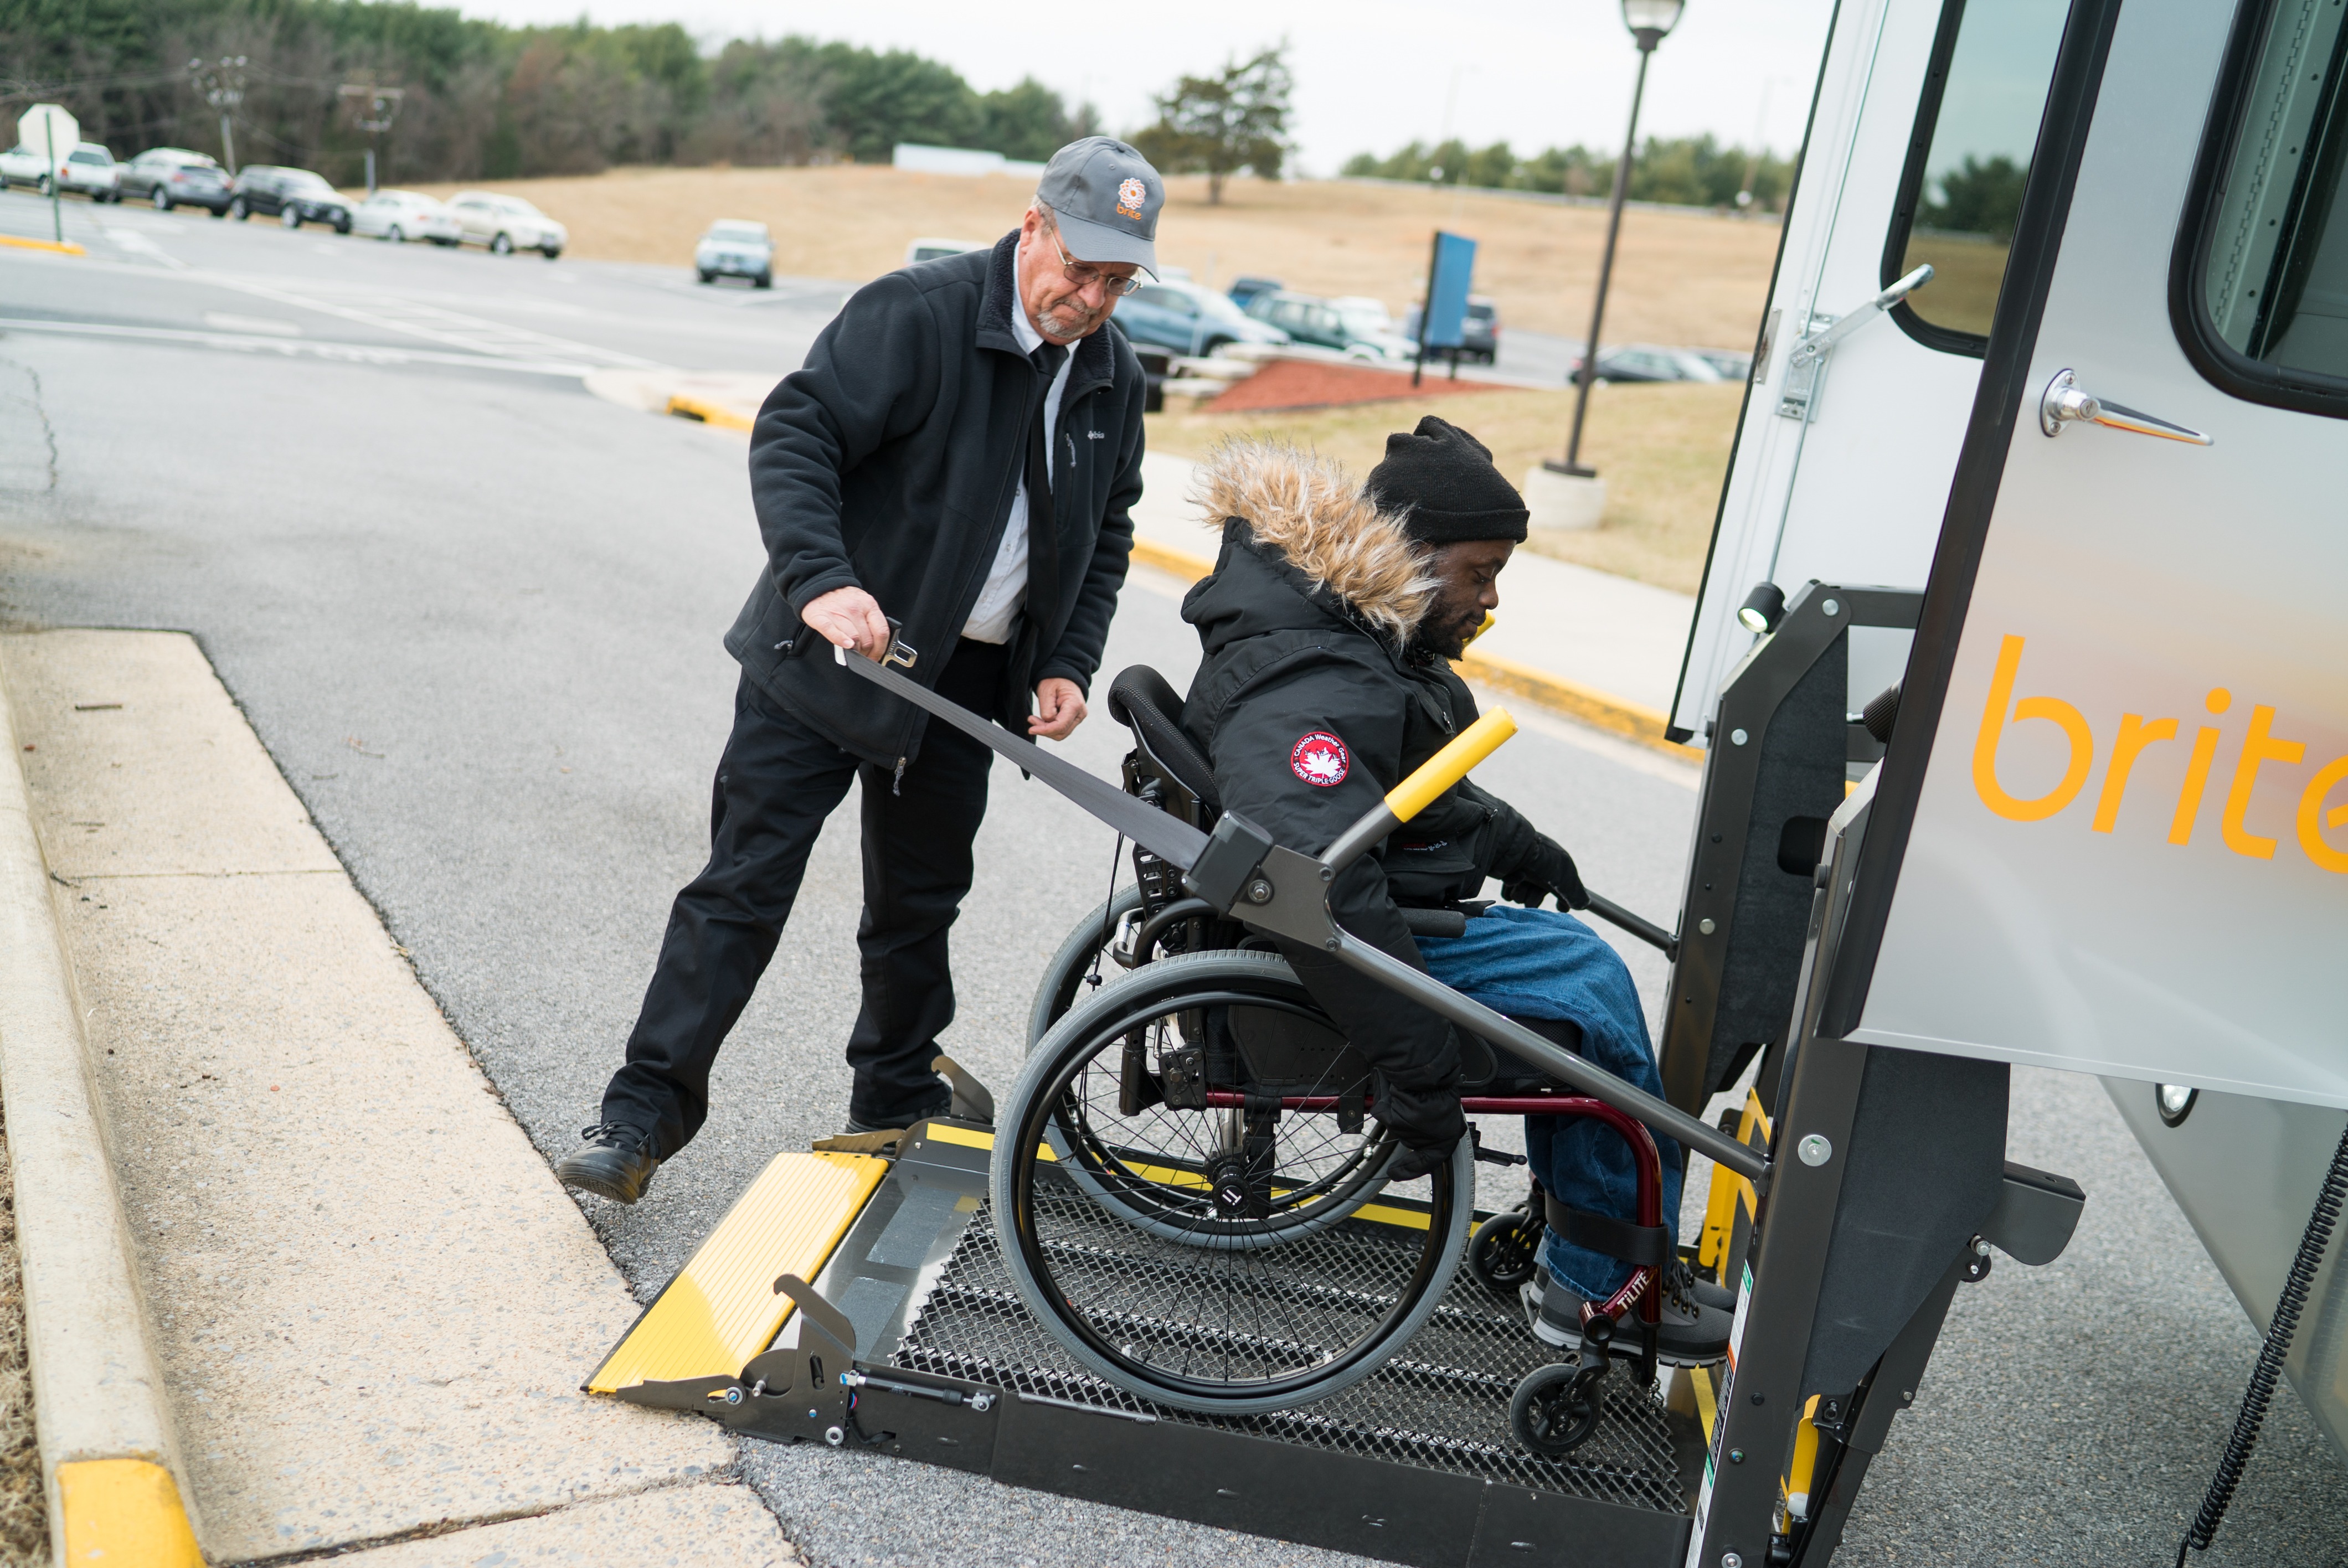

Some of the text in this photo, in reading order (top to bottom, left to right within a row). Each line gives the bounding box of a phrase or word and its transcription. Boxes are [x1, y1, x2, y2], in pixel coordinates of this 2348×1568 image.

[1116, 203, 1142, 221] brite
[1294, 736, 1315, 756] CANADA
[1315, 734, 1340, 747] Weather
[1294, 762, 1345, 784] SUPER TRIPLE GOOSE
[1222, 1189, 1242, 1206] Ti
[1617, 1272, 1649, 1310] TiLITE
